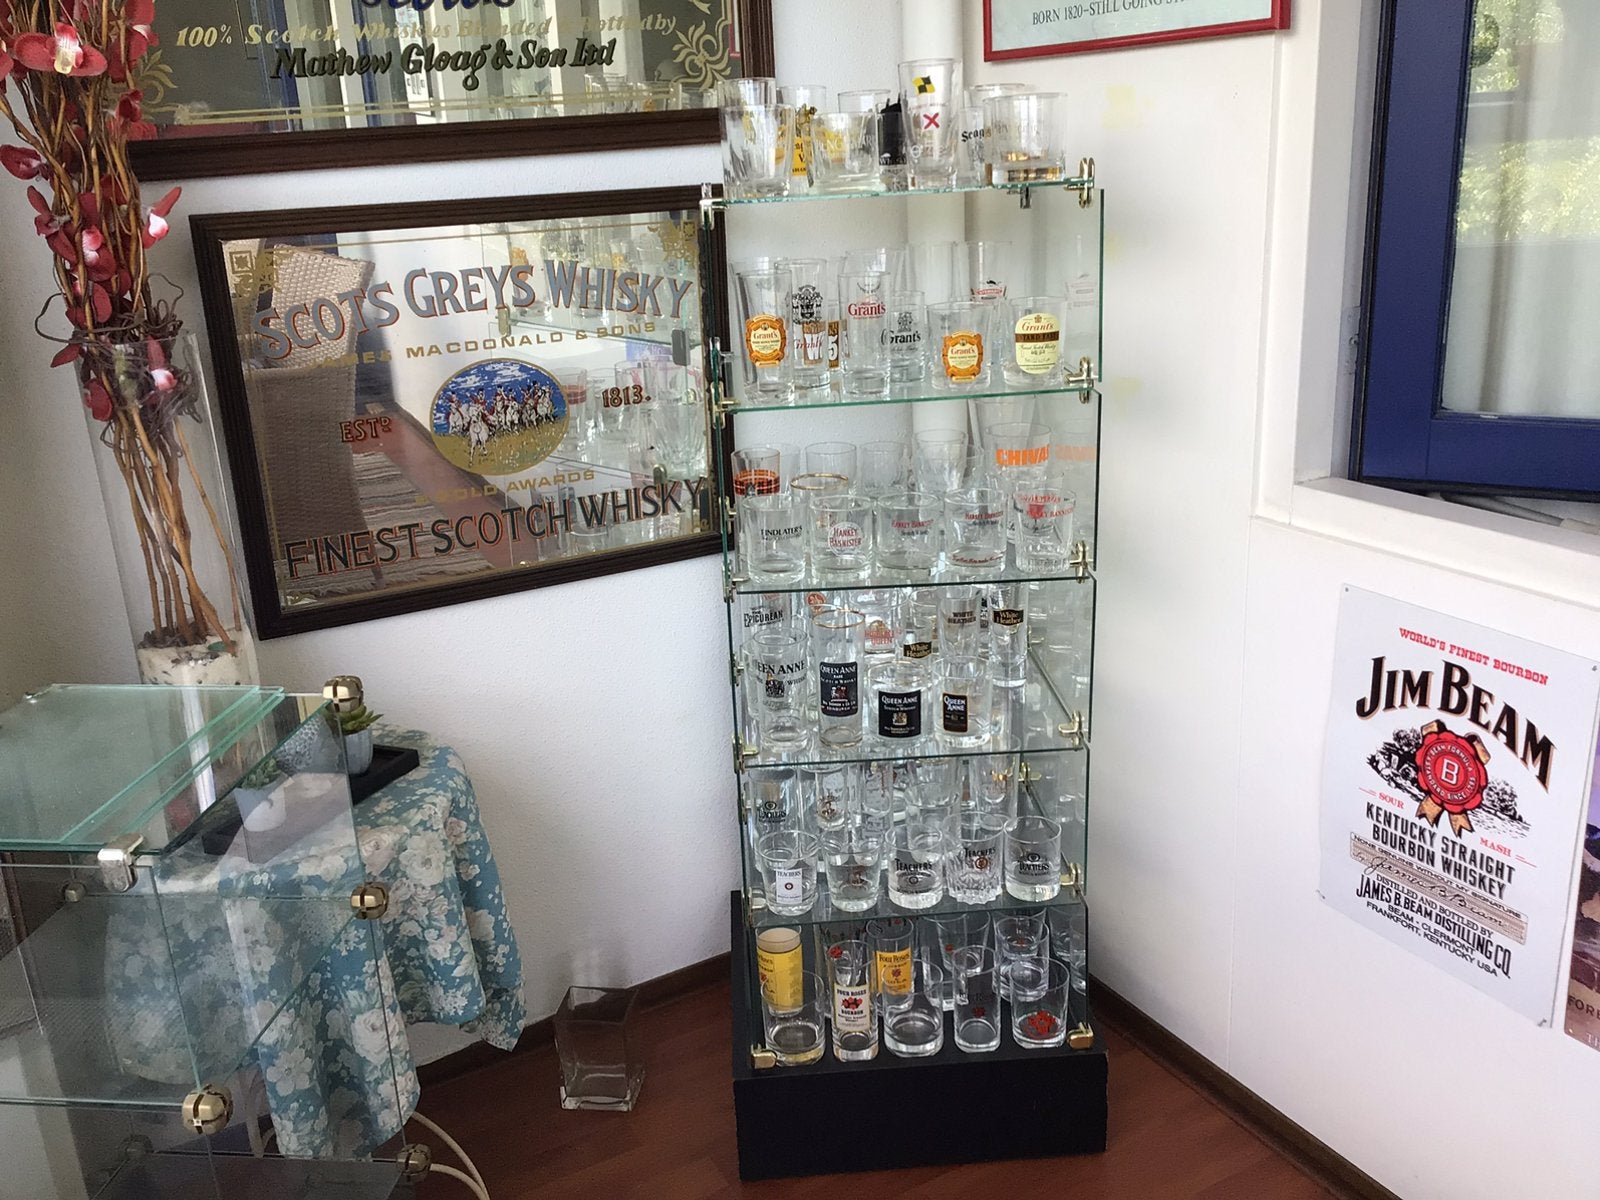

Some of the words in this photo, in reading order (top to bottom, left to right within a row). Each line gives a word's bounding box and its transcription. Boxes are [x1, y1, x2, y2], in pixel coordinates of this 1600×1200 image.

[176, 24, 232, 48] 100%
[245, 23, 340, 45] Scotch
[353, 18, 450, 42] Whiskies
[1032, 12, 1060, 25] BORN
[270, 47, 392, 78] Mathew
[401, 42, 491, 90] Gloag
[491, 38, 513, 70] &
[516, 38, 567, 69] Son
[569, 37, 617, 67] Ltd
[250, 281, 400, 360] SCOTS
[404, 264, 535, 317] GREYS
[545, 260, 694, 319] WHISKY
[407, 331, 563, 358] MACDONALD
[576, 329, 588, 340] &
[598, 322, 656, 338] SONS
[996, 444, 1049, 466] CHIVA
[507, 470, 595, 492] AWARDS
[285, 523, 421, 579] FINEST
[431, 498, 573, 557] SCOTCH
[580, 480, 705, 526] WHISKY
[833, 527, 858, 537] HANKEY
[1399, 628, 1445, 651] WORLD'S
[1449, 644, 1489, 665] FINEST
[1493, 659, 1548, 685] BOURBON
[882, 696, 902, 704] QUEEN
[943, 695, 965, 704] QUEEN
[1356, 656, 1434, 719] JIM
[1437, 659, 1557, 794] BEAM
[1441, 758, 1459, 785] B
[1379, 792, 1404, 809] SOUR
[1366, 802, 1436, 848] KENTUCKY
[1441, 836, 1515, 884] STRAIGHT
[1373, 824, 1435, 867] BOURBON
[1441, 855, 1506, 900] WHISKEY
[1480, 837, 1511, 857] MASH
[1356, 874, 1392, 903] JAMES
[1404, 896, 1432, 921] BEAM
[1435, 912, 1493, 960] DISTILLING
[1377, 874, 1418, 899] DISTILLED
[1419, 897, 1437, 910] AND
[1439, 906, 1478, 931] BOTTLED
[1480, 930, 1493, 938] BY
[1388, 905, 1413, 924] BEAM
[1422, 922, 1475, 954] CLERMONT
[1424, 931, 1475, 963] KENTUCKY
[1477, 960, 1498, 977] USA
